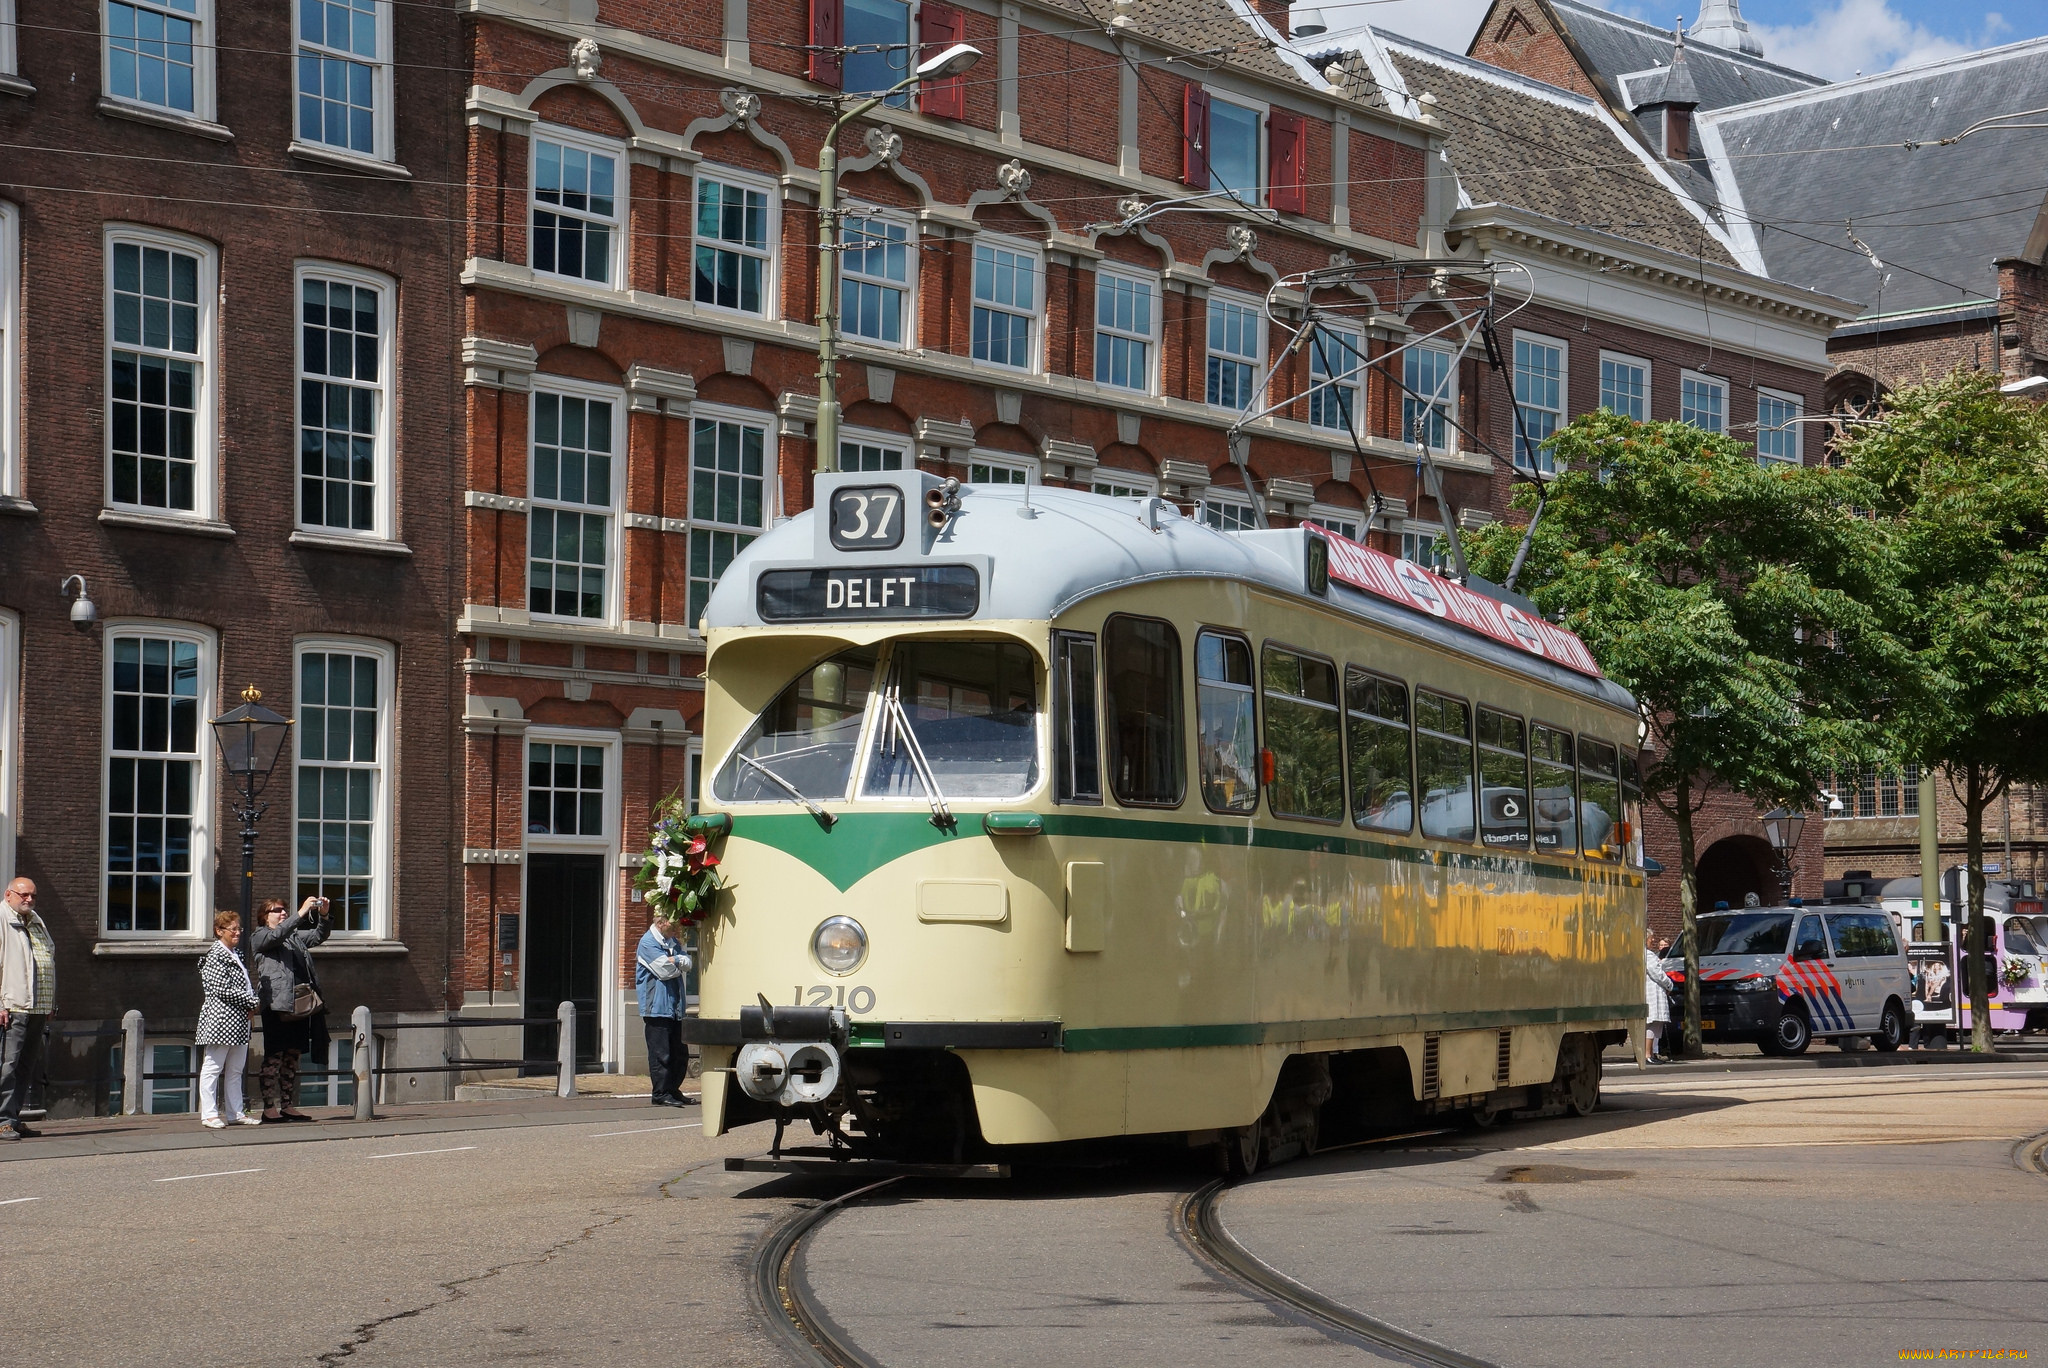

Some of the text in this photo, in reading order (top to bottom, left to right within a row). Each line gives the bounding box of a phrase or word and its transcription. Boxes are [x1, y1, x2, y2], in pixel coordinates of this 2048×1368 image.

[840, 494, 898, 540] 37
[826, 577, 916, 609] DELFT
[1310, 528, 1598, 674] MARTINI MARTINI MARTINI
[1497, 927, 1515, 956] 1210
[1845, 978, 1865, 989] POLITIE
[794, 985, 876, 1014] 1210
